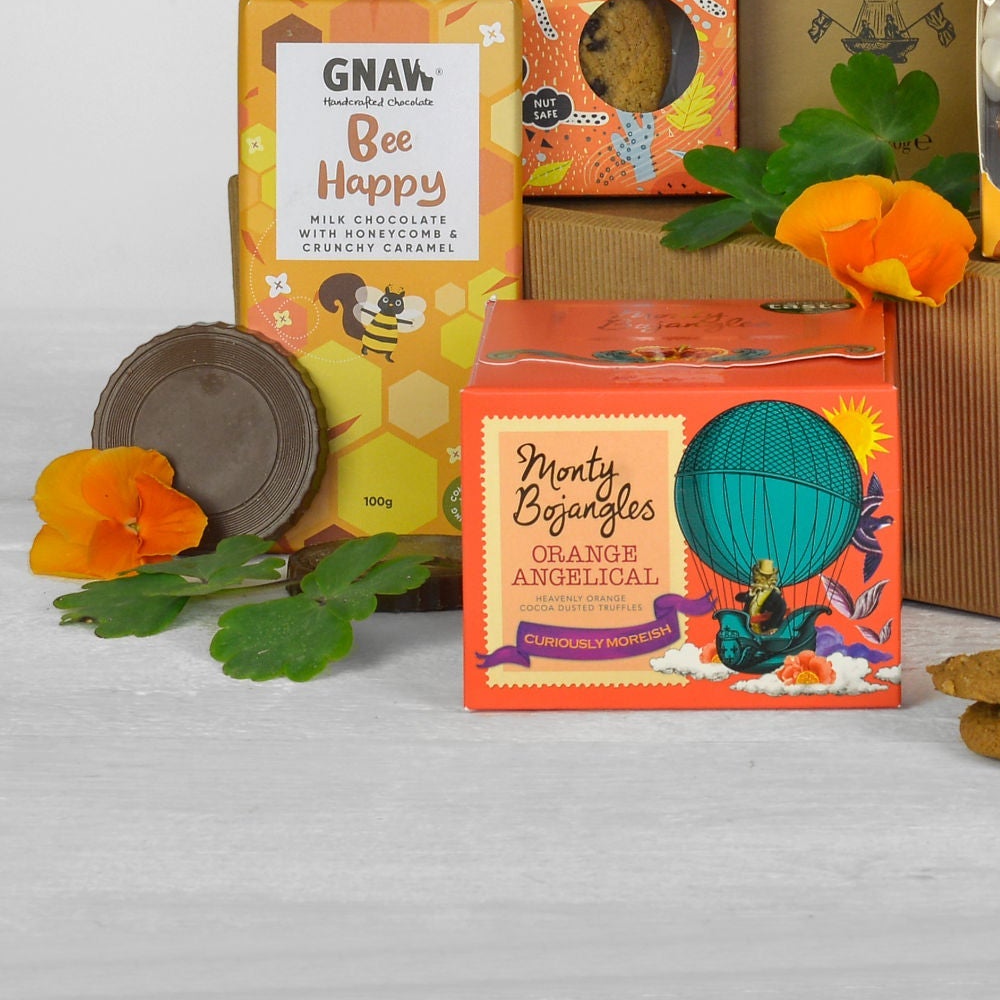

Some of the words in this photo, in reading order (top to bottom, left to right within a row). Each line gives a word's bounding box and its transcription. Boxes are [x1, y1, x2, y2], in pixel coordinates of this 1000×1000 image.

[323, 57, 434, 92] GNAW
[324, 96, 384, 109] Handcrafted
[388, 97, 434, 107] Chocolate
[534, 98, 557, 108] NUT
[534, 109, 558, 120] SAFE
[348, 113, 413, 163] Bee
[317, 160, 447, 207] Happy
[310, 215, 346, 225] MILK
[354, 215, 447, 225] CHOCOLATE
[299, 229, 337, 239] WITH
[345, 229, 442, 239] HONEYCOMB
[449, 229, 458, 239] &
[302, 242, 375, 253] CRUNCHY
[383, 242, 455, 253] CARAMEL
[517, 442, 620, 502] Monty
[364, 496, 393, 509] 100g
[513, 482, 656, 538] Bojangles
[532, 545, 638, 563] ORANGE
[511, 568, 659, 586] ANGELICAL
[536, 595, 582, 603] HEAVENLY
[587, 594, 626, 602] ORANGE
[519, 604, 554, 612] COCOA
[558, 604, 594, 612] DUSTED
[599, 603, 643, 612] TRUFFLES
[524, 633, 604, 649] CURIOUSLY
[606, 623, 673, 648] MOREISH
